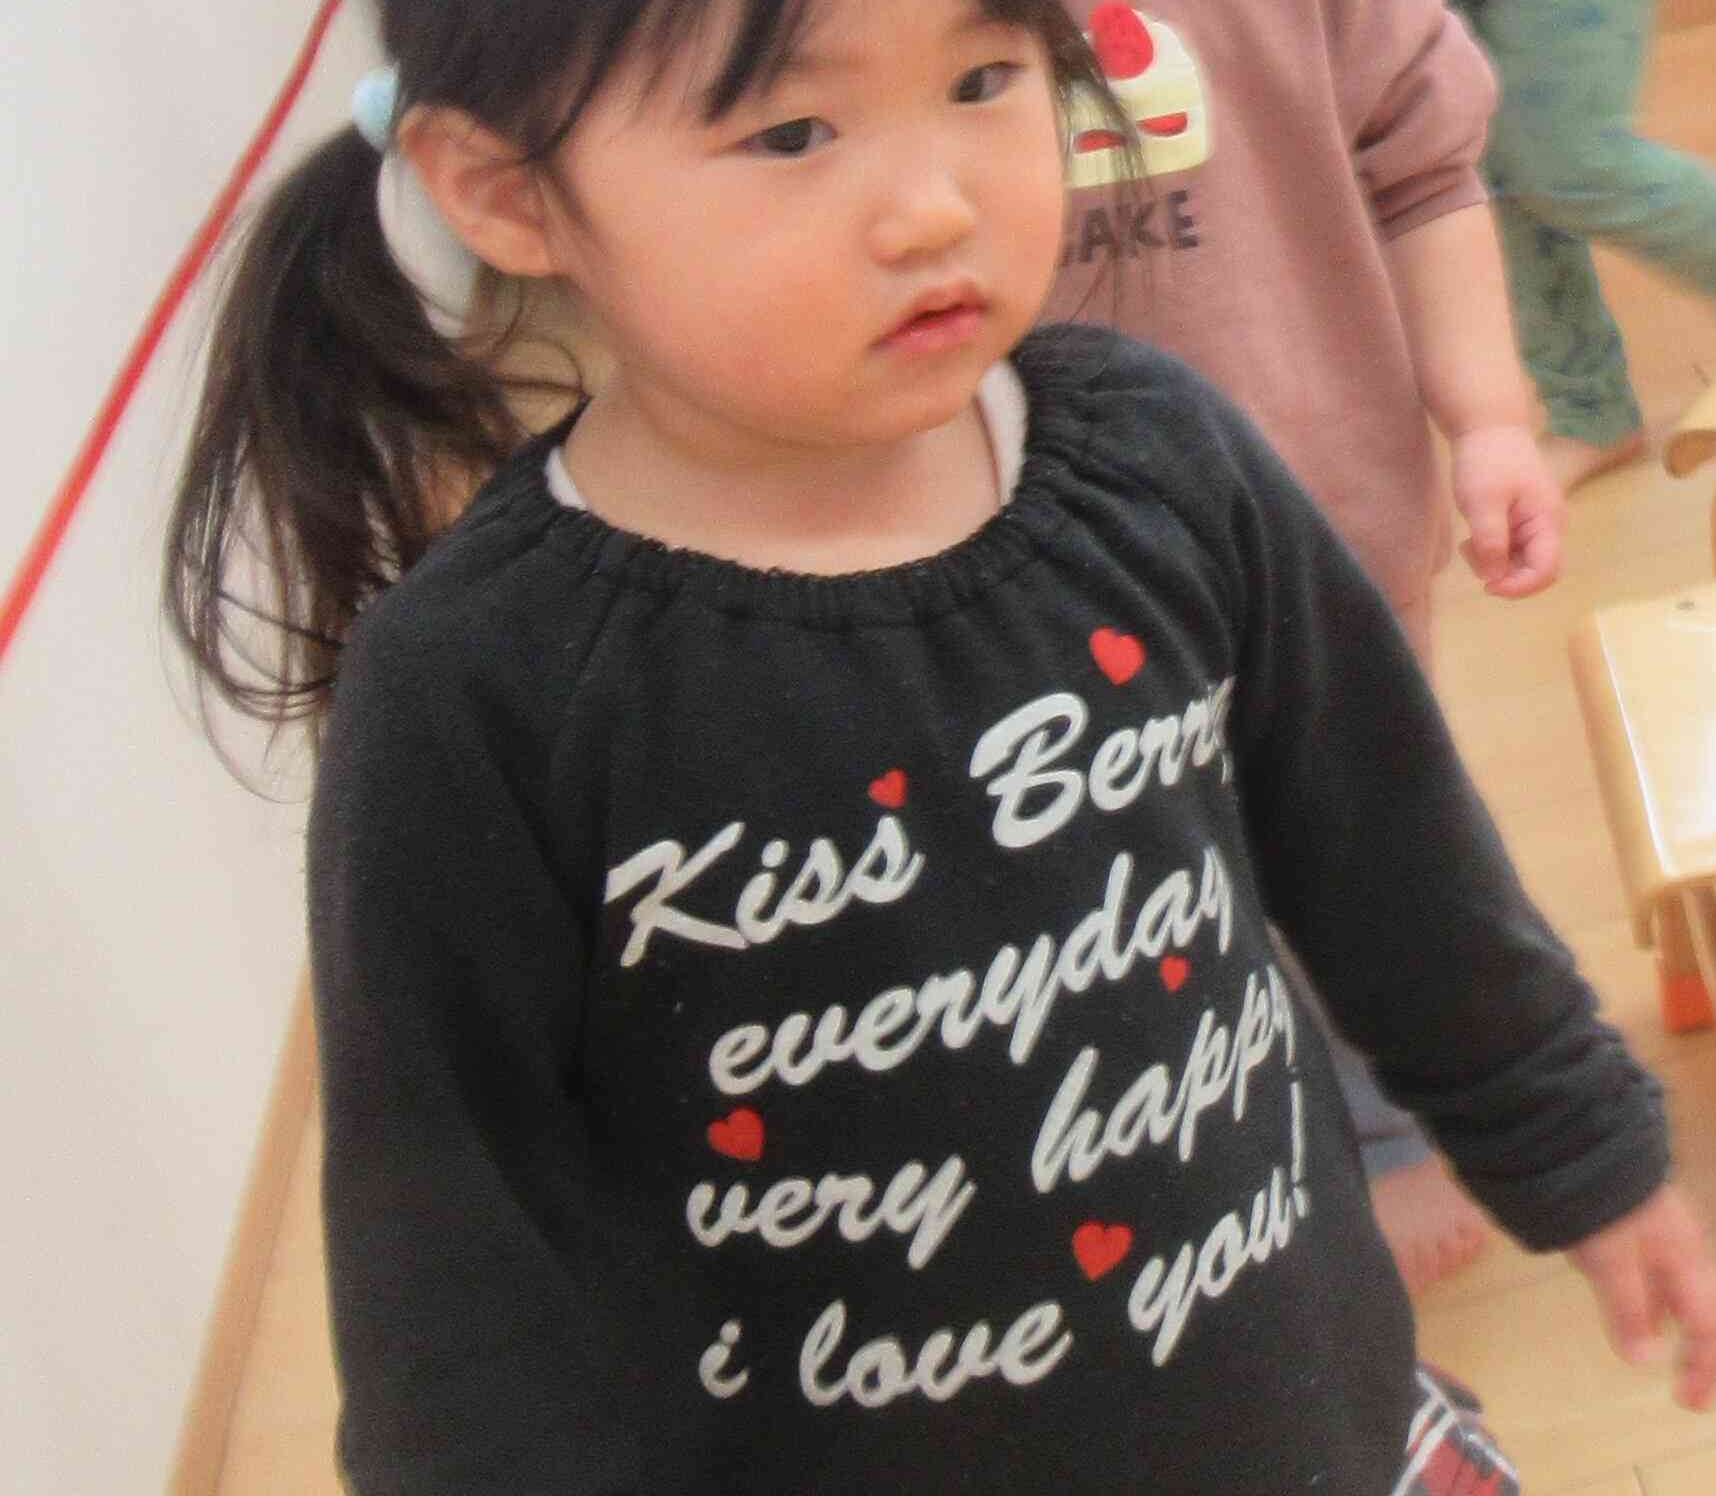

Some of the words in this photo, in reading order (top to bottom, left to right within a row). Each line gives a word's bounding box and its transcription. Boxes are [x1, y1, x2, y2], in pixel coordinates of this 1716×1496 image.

[1061, 189, 1200, 267] AKE
[604, 815, 925, 967] Kiss
[708, 844, 1236, 1095] everyday
[686, 1154, 976, 1270] very
[1030, 962, 1298, 1194] happy
[699, 1321, 748, 1399] i
[799, 1300, 1074, 1408] love
[1127, 1078, 1310, 1367] you!
